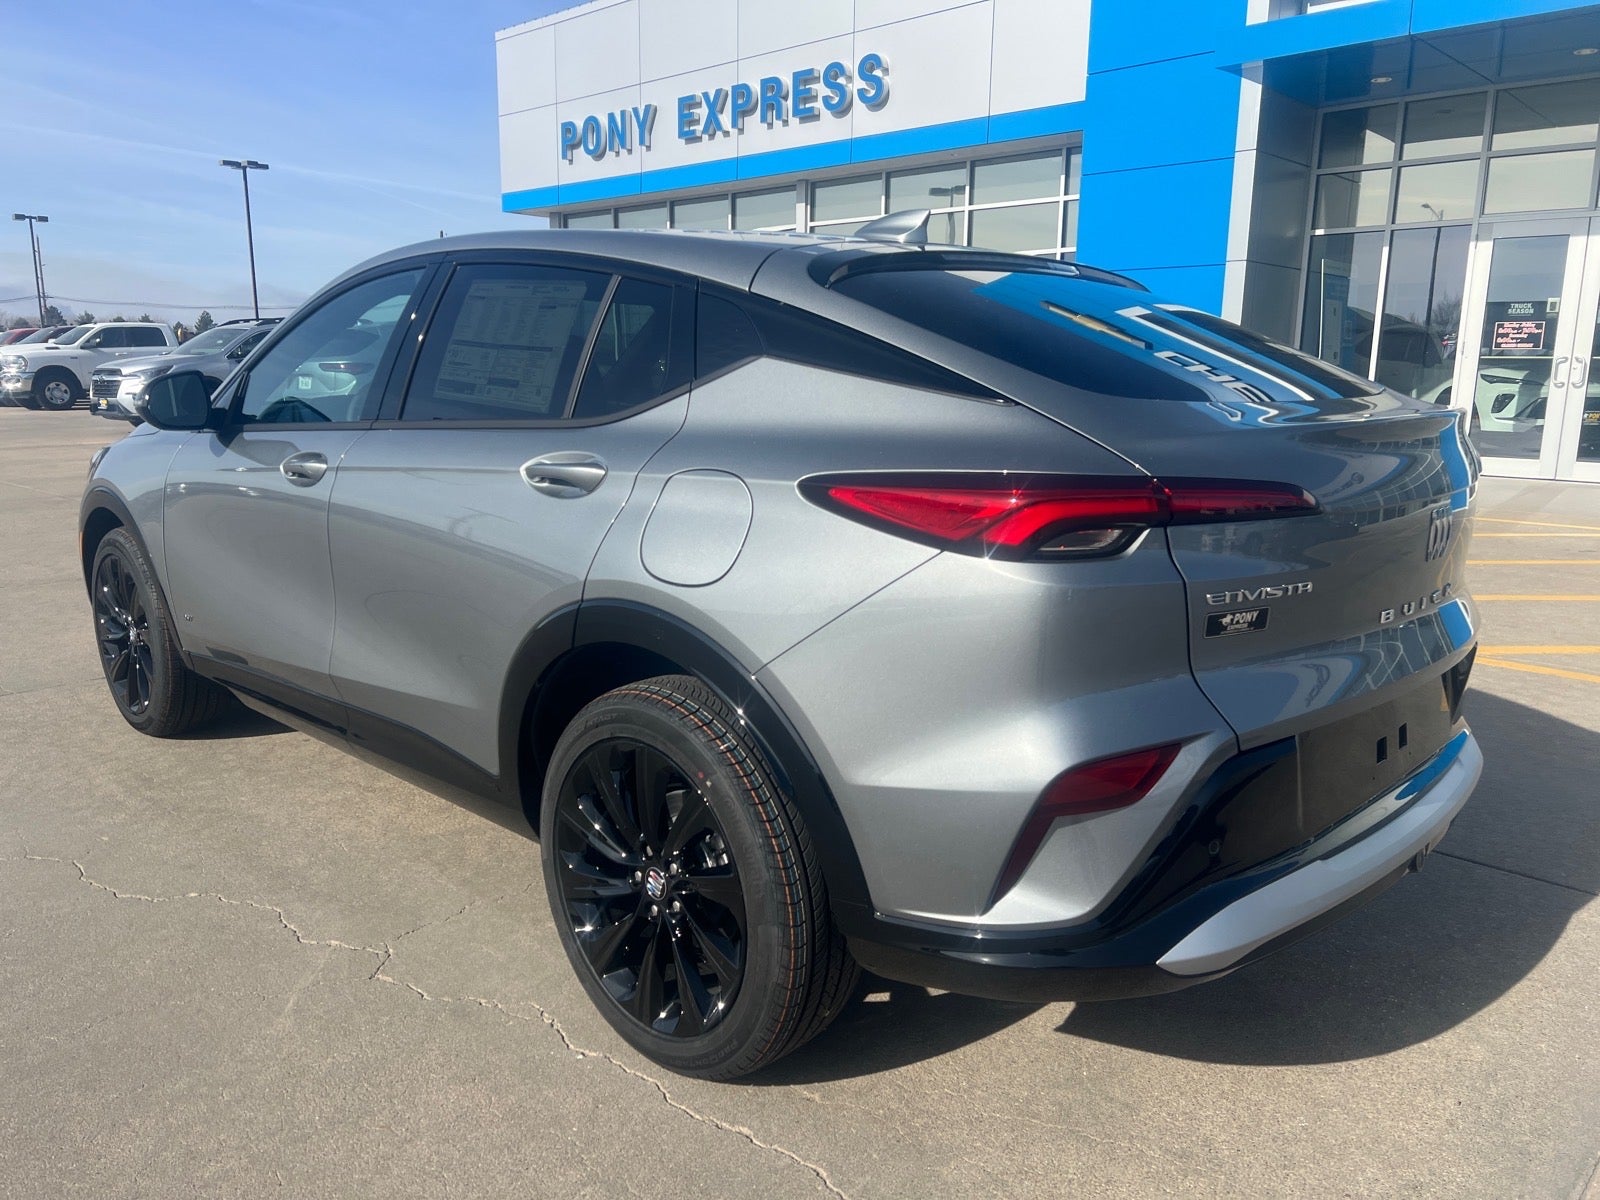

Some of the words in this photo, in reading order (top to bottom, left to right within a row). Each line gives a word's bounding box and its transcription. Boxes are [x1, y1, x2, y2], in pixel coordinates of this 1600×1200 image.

[560, 103, 656, 163] PONY
[677, 53, 889, 144] EXPRESS
[1206, 581, 1314, 605] ENVISTA
[1233, 610, 1260, 624] PONY
